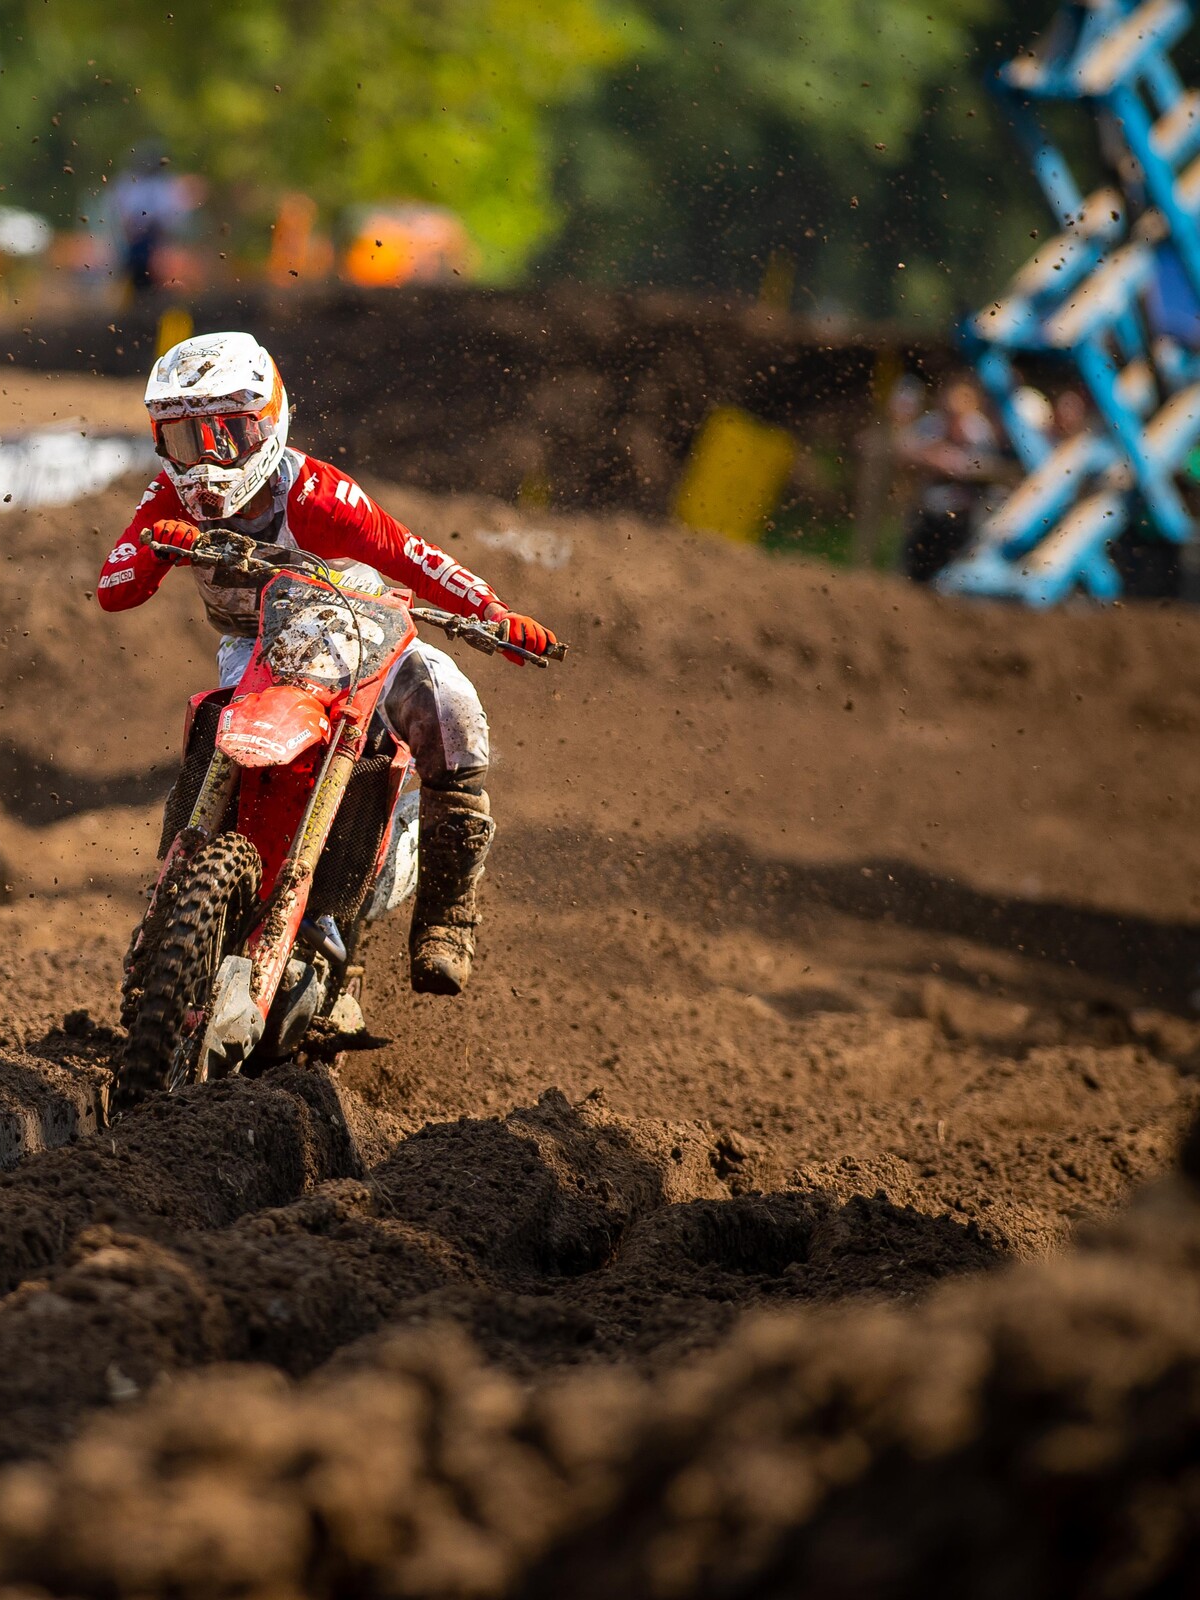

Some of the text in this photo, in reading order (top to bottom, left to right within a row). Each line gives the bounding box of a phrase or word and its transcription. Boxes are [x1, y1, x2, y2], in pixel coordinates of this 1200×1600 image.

[230, 436, 280, 505] GEICO
[222, 733, 287, 755] GEICO
[235, 745, 273, 760] ONDA
